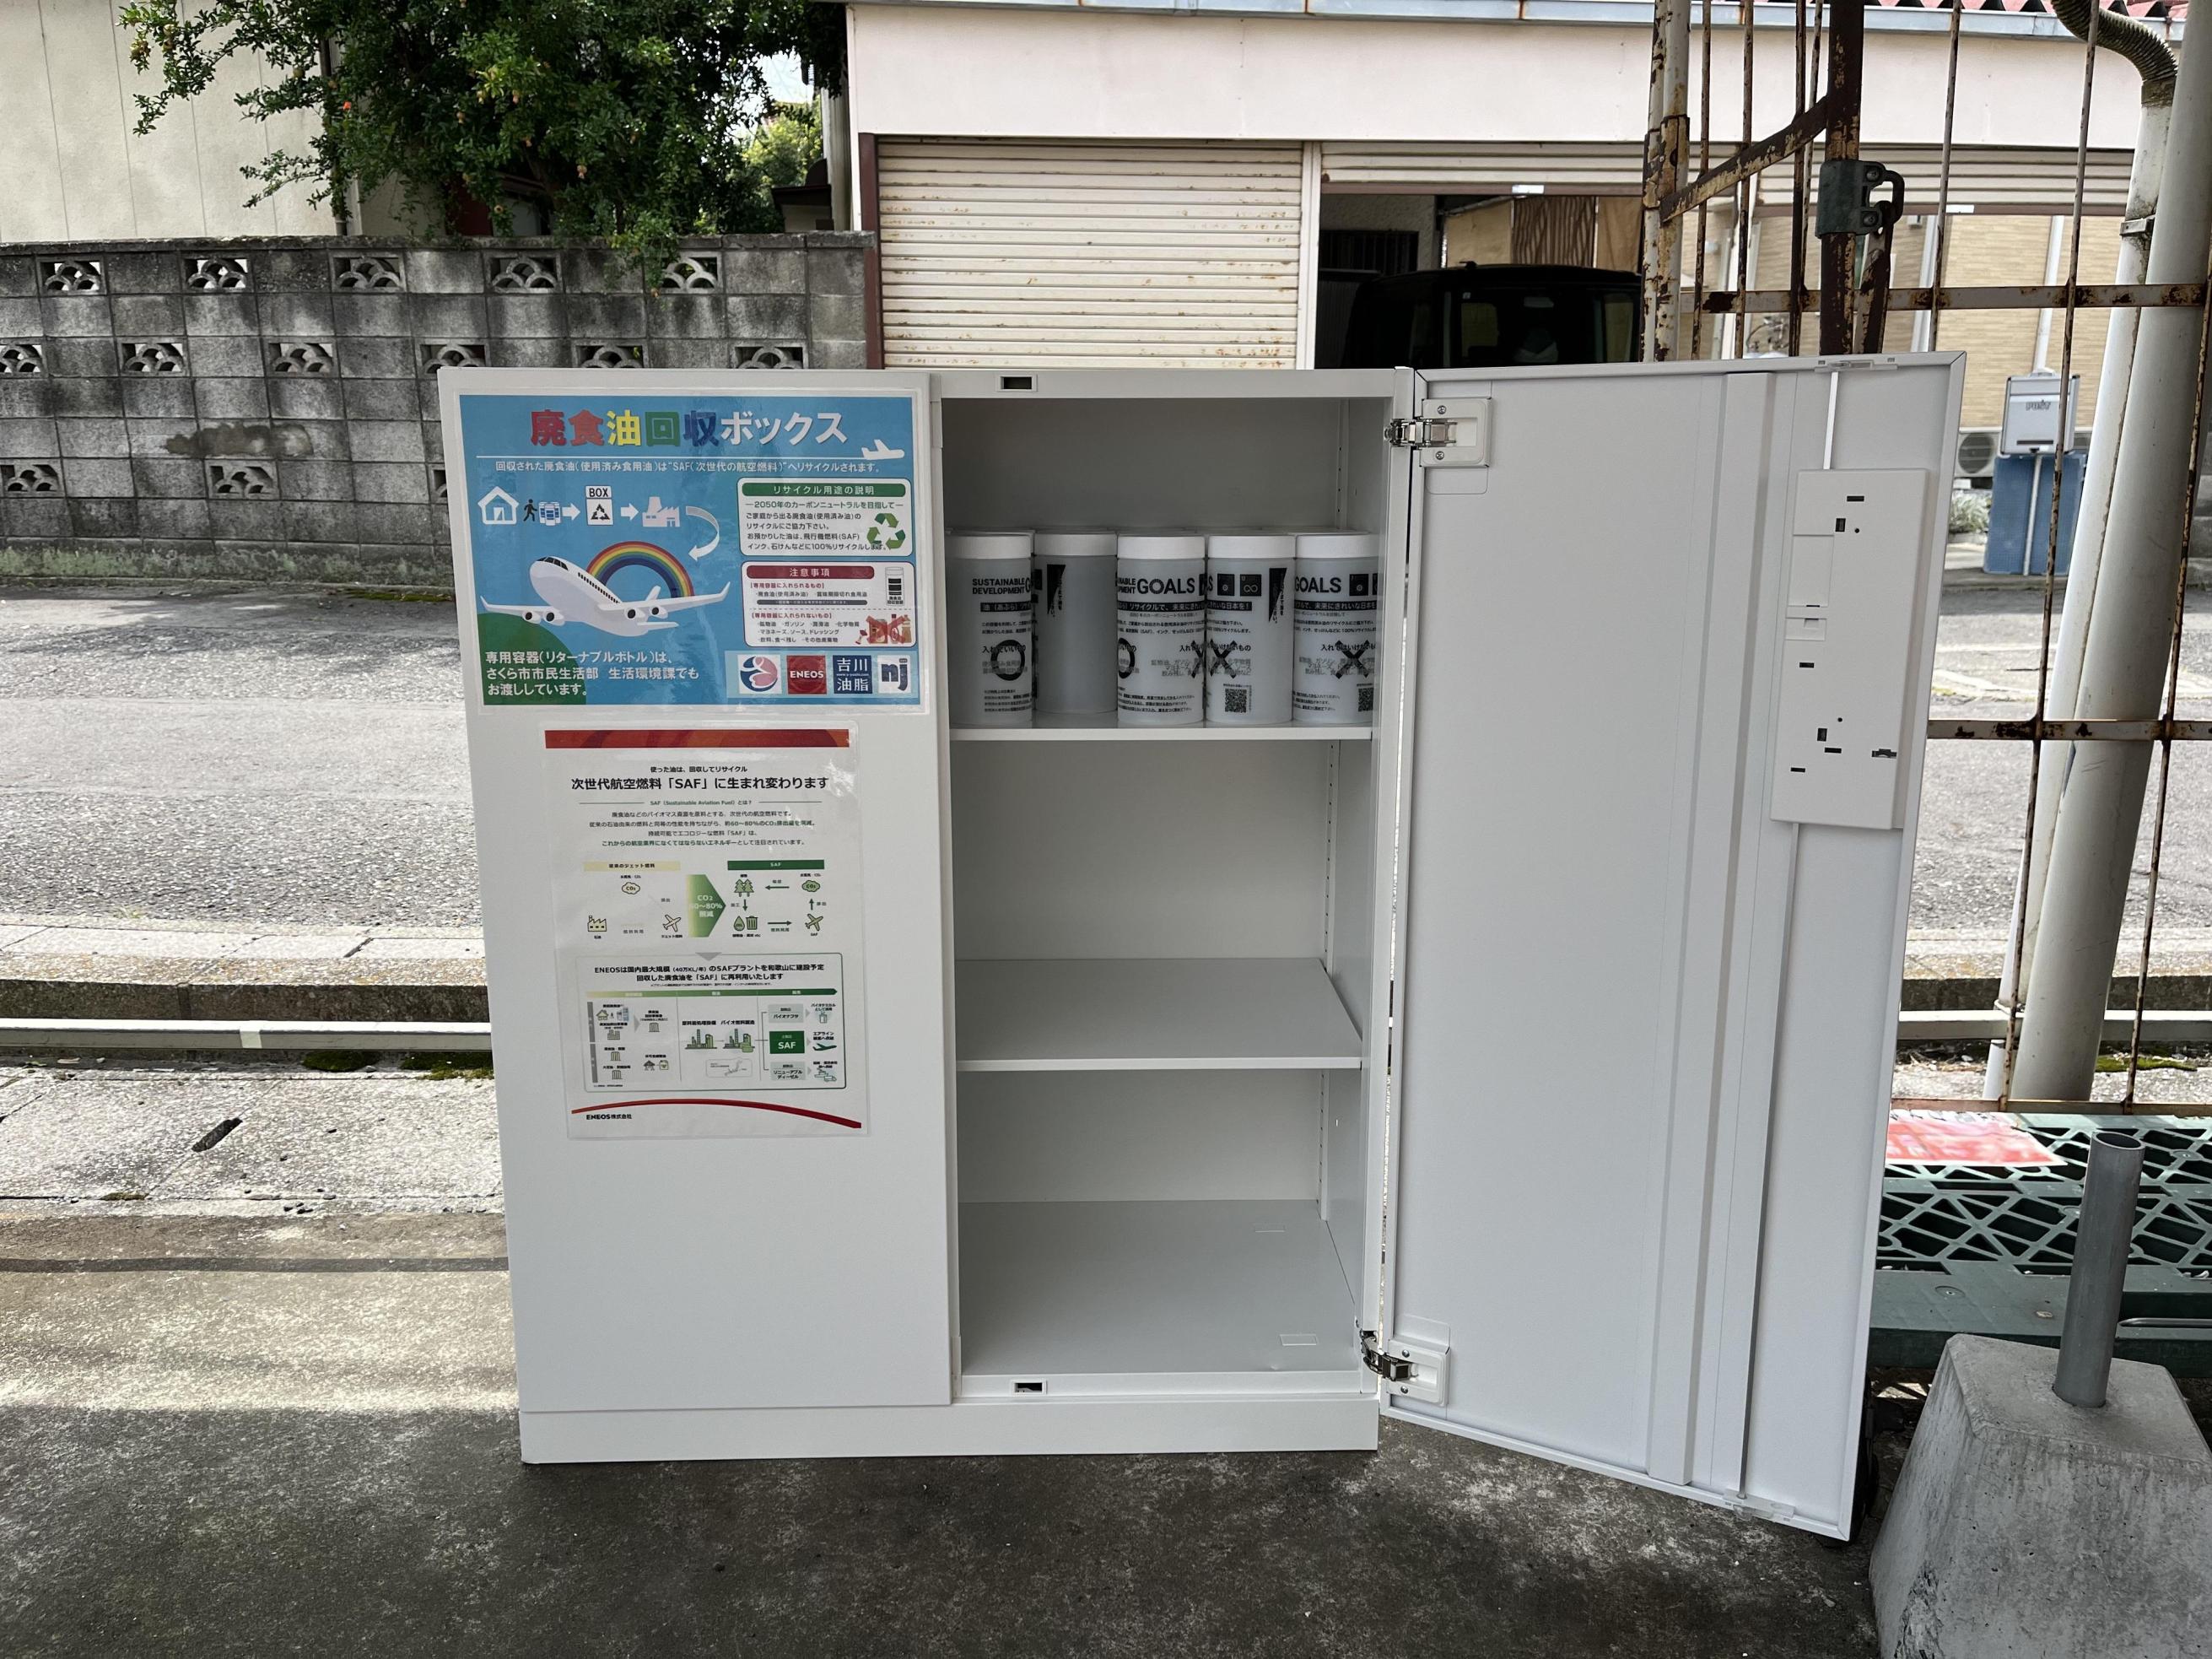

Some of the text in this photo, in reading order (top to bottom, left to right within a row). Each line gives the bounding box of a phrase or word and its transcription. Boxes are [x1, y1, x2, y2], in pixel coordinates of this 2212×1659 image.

[530, 408, 848, 447] 廃食油回収ボックス
[588, 488, 609, 498] BOX
[773, 485, 875, 495] リサイクル用途の説明
[789, 568, 831, 577] 注意事項
[1136, 577, 1195, 595] GOALS
[1294, 576, 1342, 593] GOALS
[836, 657, 868, 672] 吉川
[486, 667, 699, 680] さくら市市民生活部 生活環境課でも
[790, 670, 825, 678] ENEOS
[488, 684, 588, 696] お渡ししています。
[836, 678, 868, 691] 油脂
[571, 776, 828, 790] 次世代航空燃料「SAF」に生まれ変わります
[778, 1041, 796, 1050] SAF
